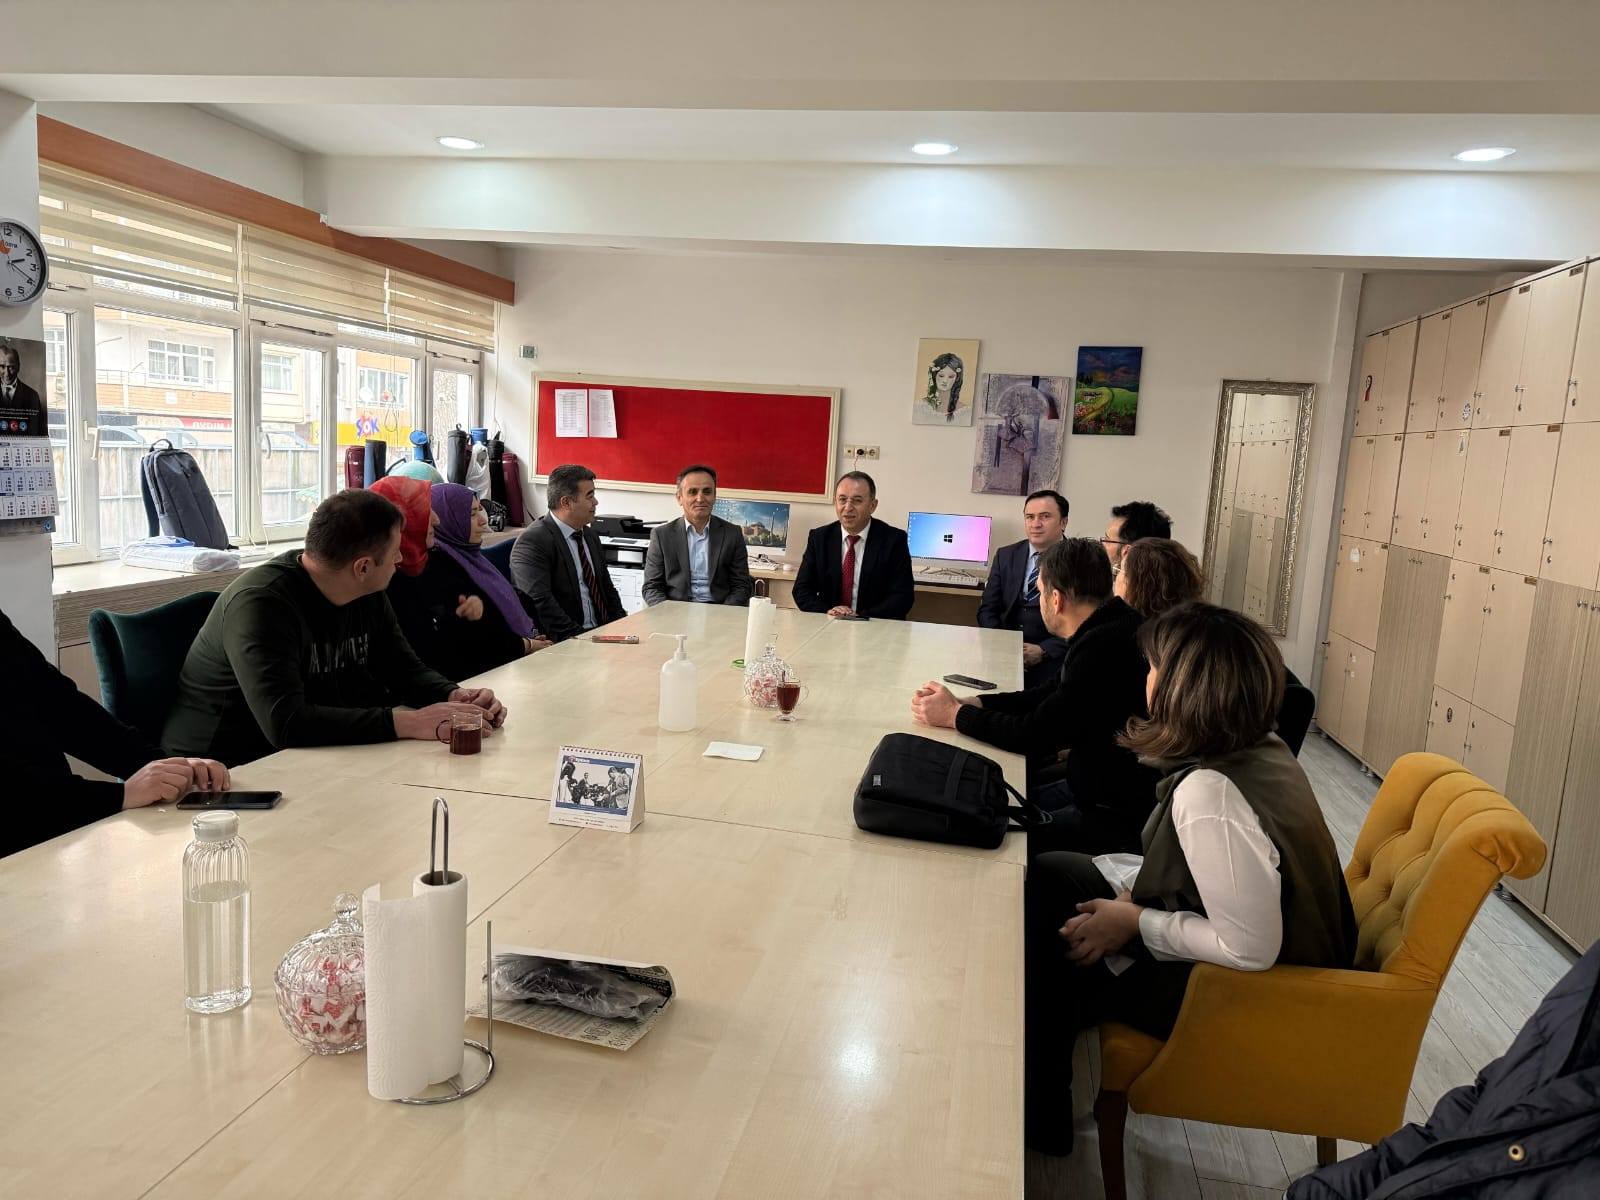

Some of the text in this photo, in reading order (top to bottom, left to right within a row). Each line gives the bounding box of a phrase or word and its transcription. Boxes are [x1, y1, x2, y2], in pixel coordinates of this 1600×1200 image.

[4, 228, 12, 236] 12
[26, 248, 33, 257] 2
[30, 263, 36, 272] 3
[5, 288, 12, 296] 6
[17, 286, 24, 294] 5
